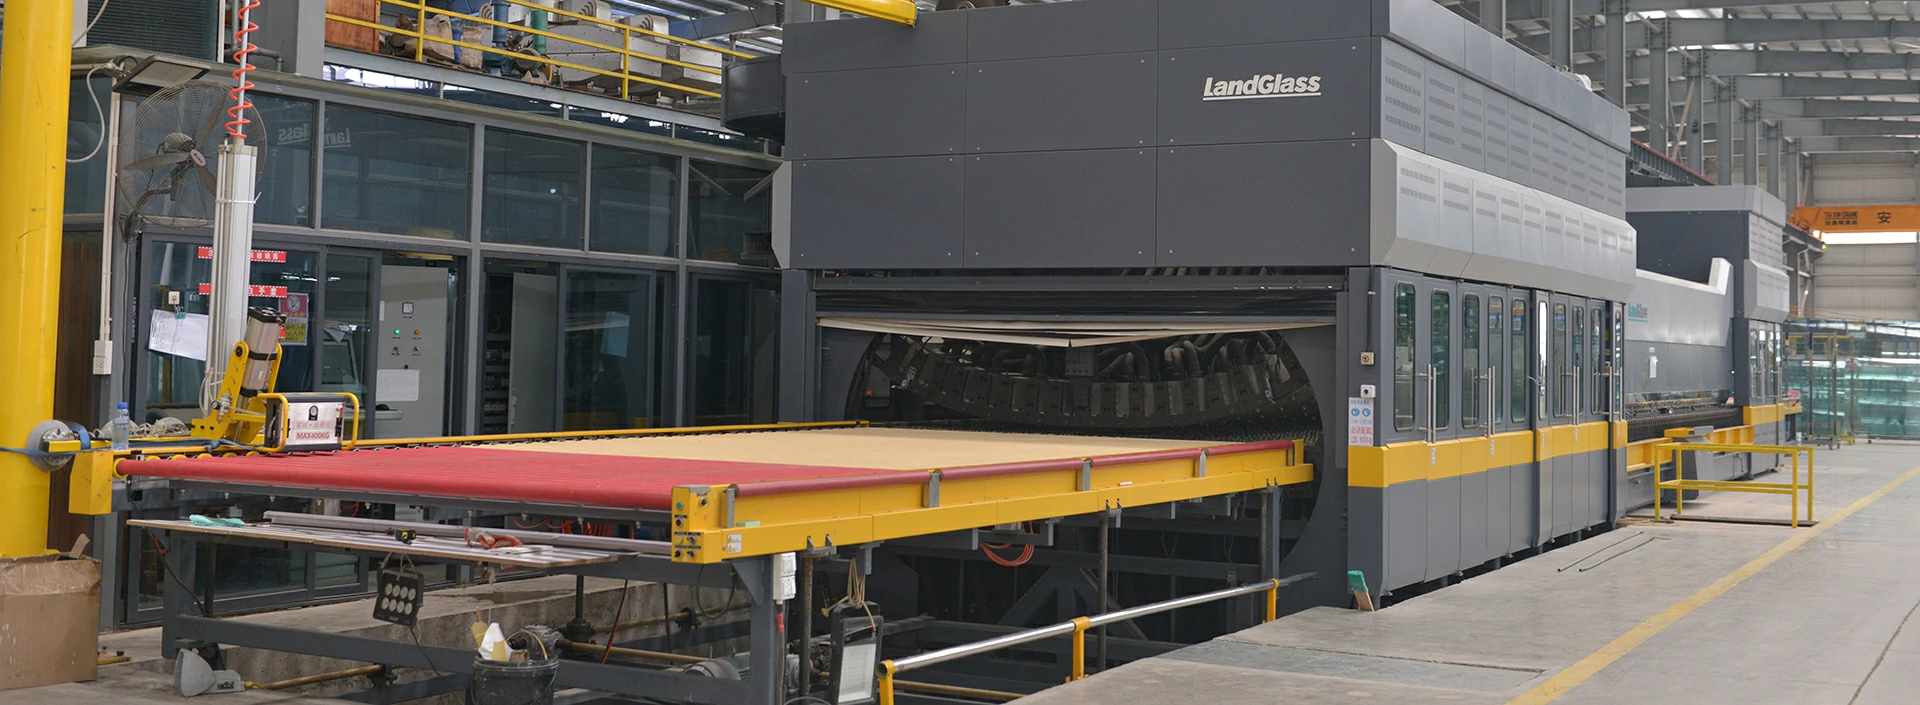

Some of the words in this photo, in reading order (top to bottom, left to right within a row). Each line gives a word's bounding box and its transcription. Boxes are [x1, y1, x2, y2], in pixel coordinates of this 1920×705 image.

[1203, 73, 1322, 97] LandGlass
[1876, 210, 1892, 224] 安
[296, 431, 330, 440] MAX400KG
